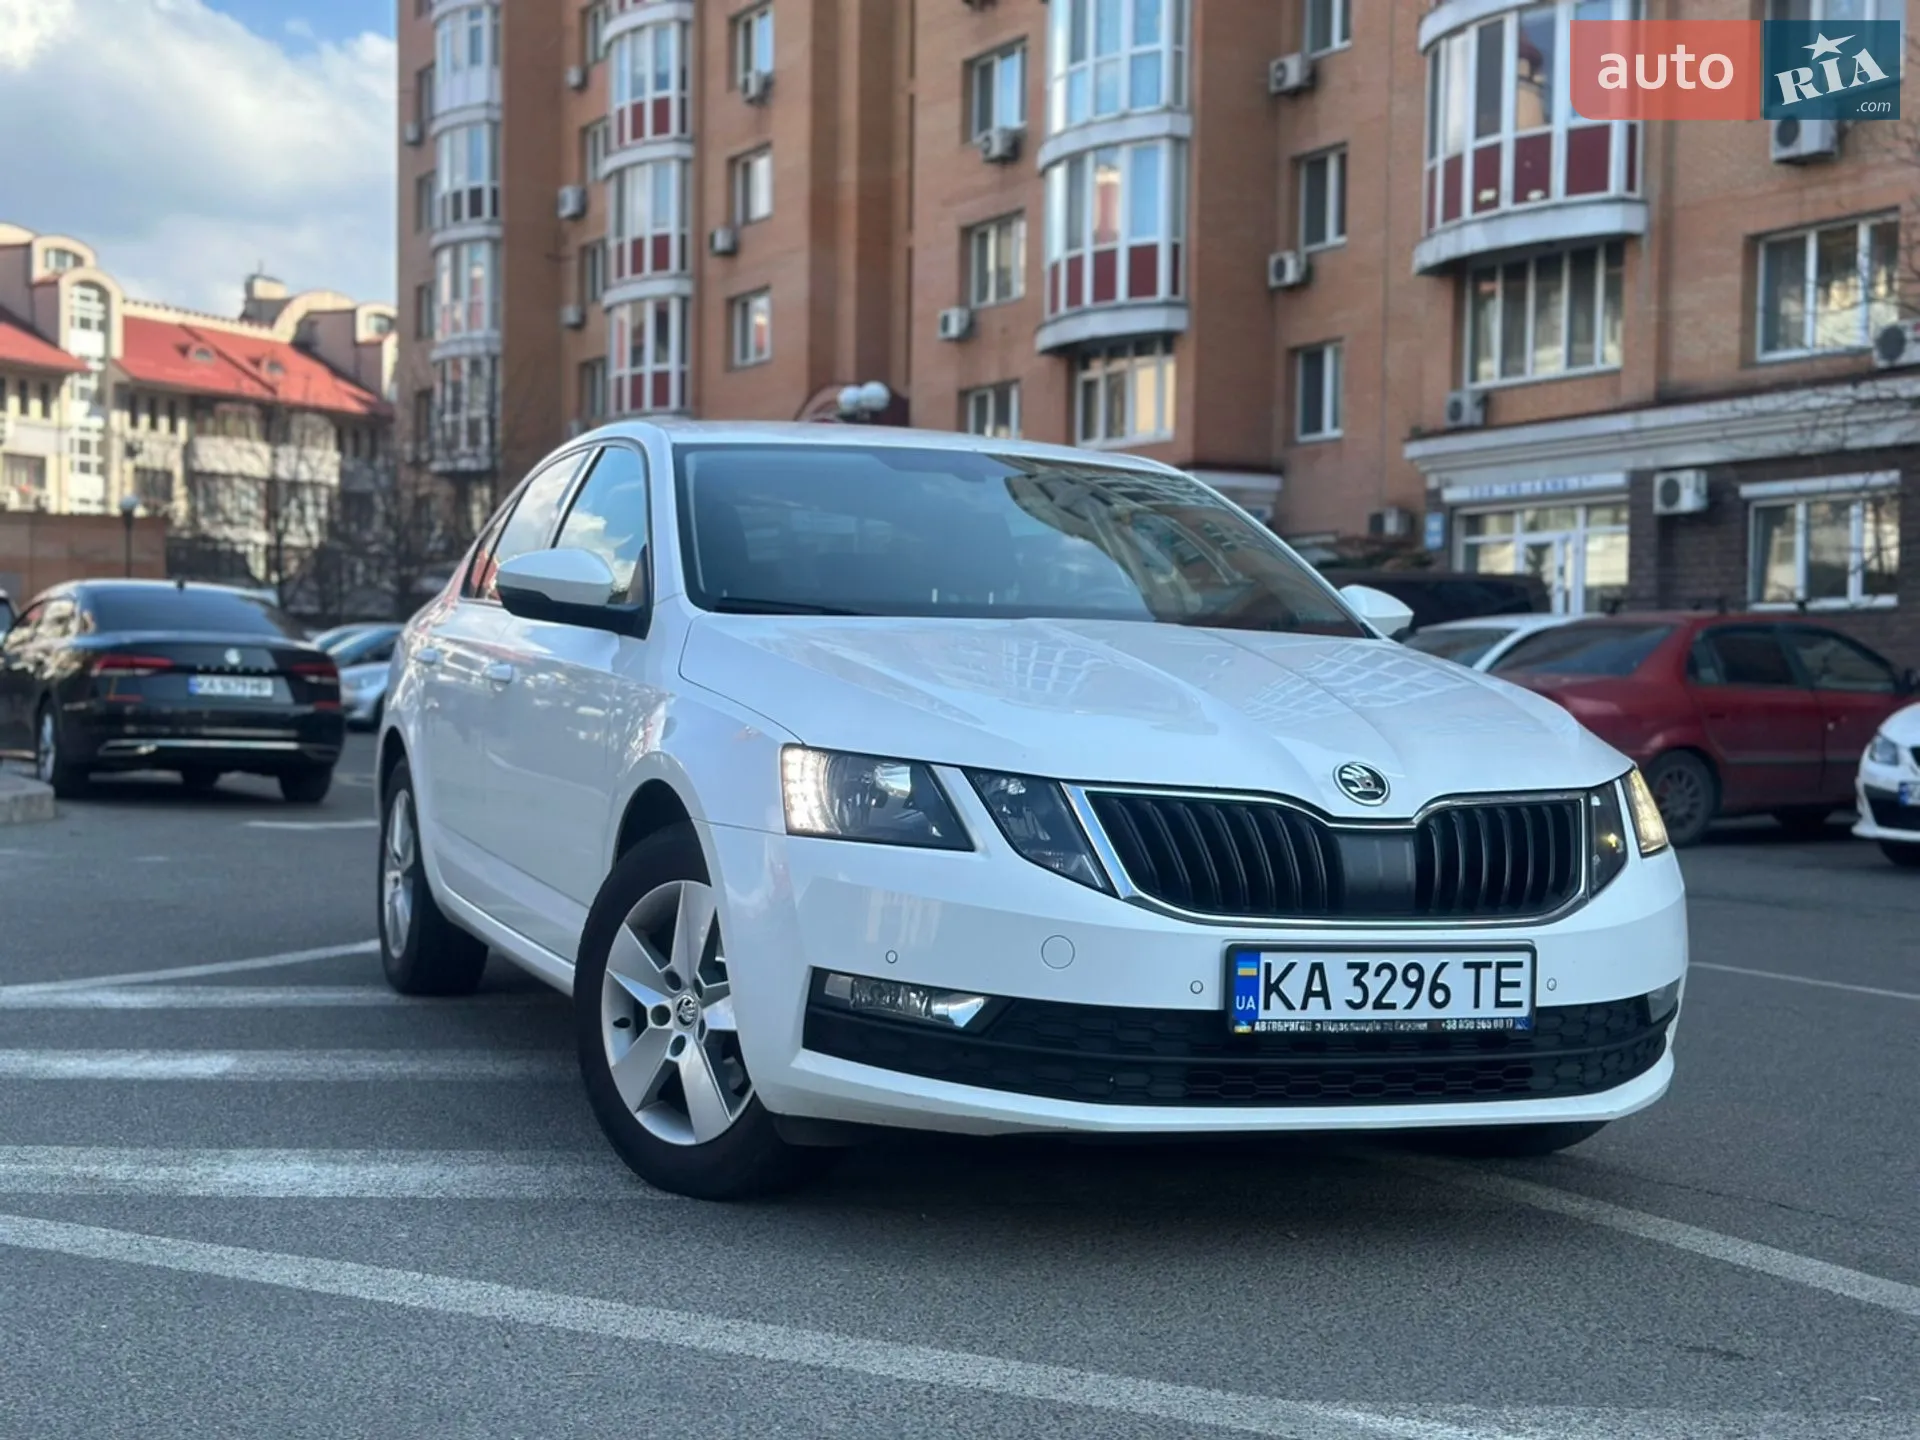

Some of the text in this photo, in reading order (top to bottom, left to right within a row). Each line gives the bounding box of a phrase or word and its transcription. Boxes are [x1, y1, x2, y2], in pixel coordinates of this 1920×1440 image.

[1263, 961, 1524, 1011] KA 3296 TE
[1236, 995, 1256, 1010] UA
